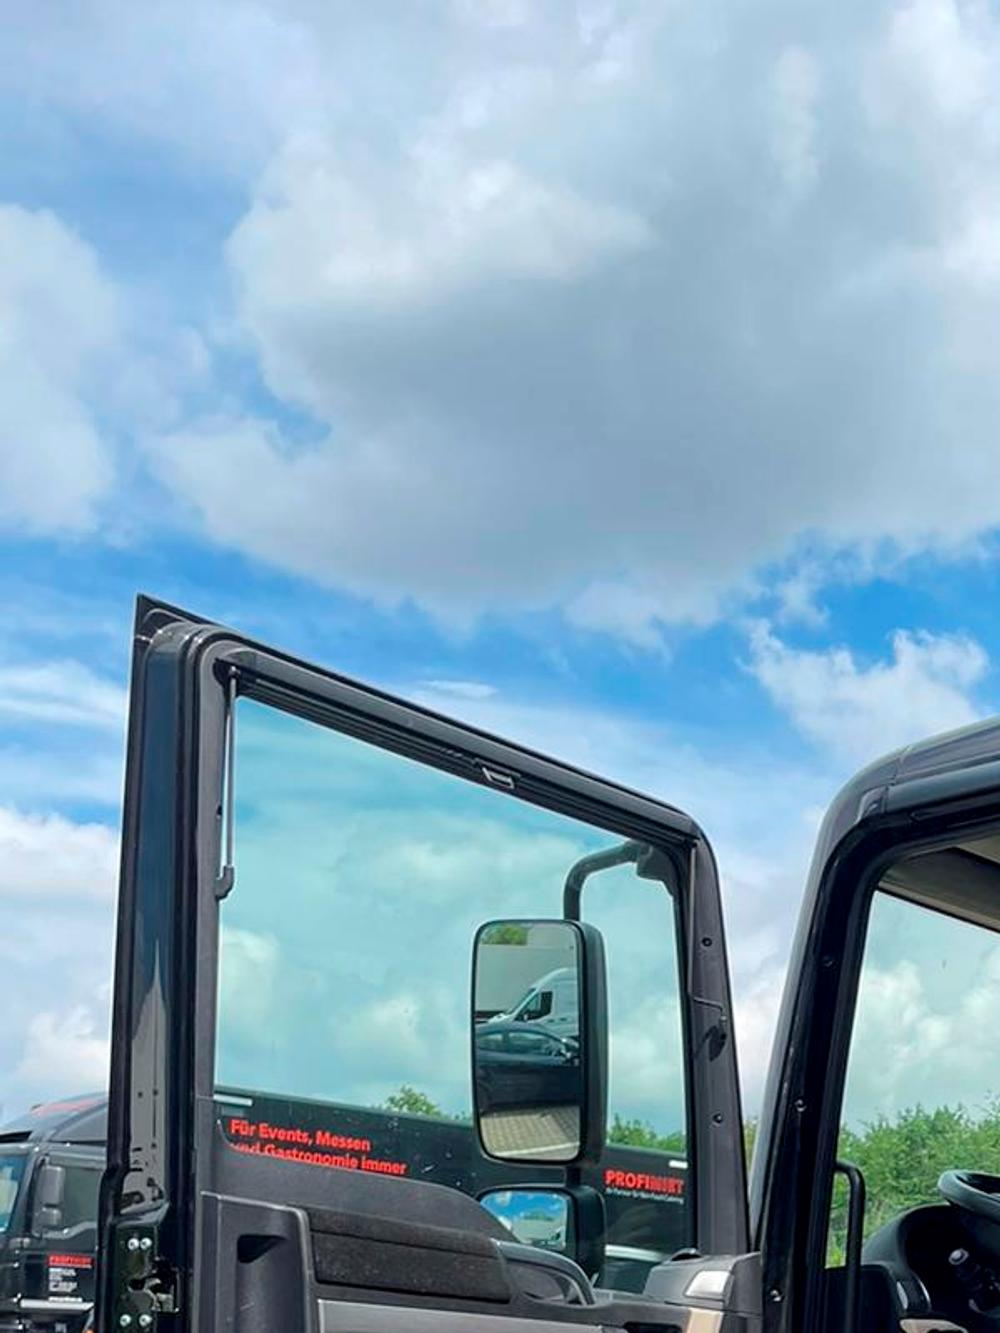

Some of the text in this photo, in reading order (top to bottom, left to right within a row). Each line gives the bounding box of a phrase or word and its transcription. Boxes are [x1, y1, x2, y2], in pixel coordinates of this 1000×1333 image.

[230, 1119, 371, 1152] Für Events, Messen
[264, 1143, 359, 1169] Gastronomie
[361, 1155, 407, 1175] immer
